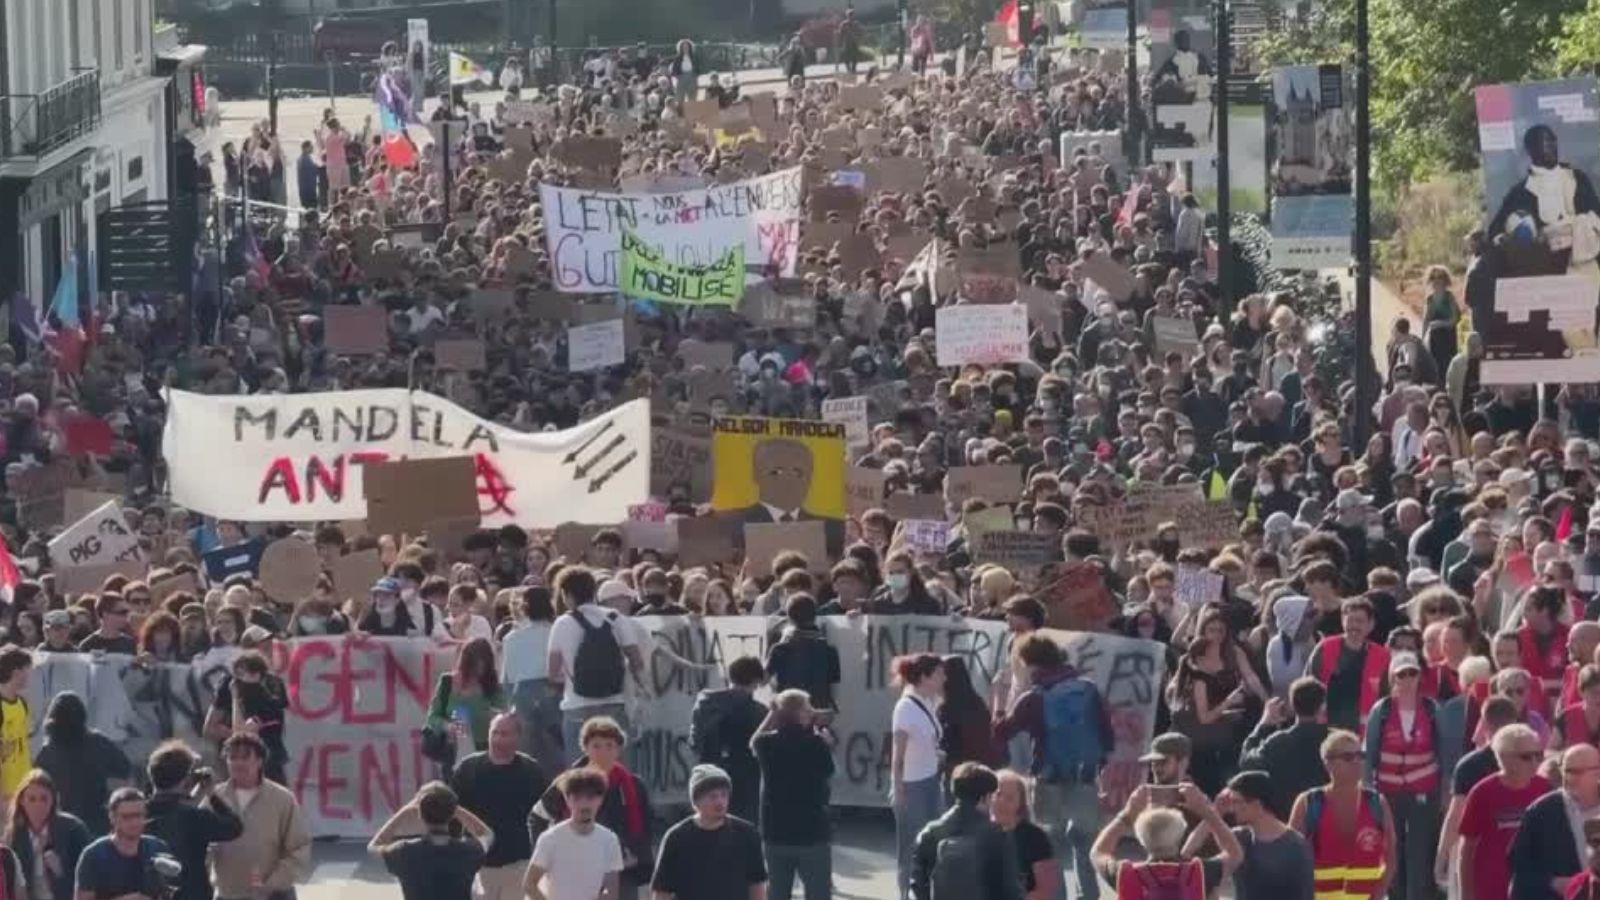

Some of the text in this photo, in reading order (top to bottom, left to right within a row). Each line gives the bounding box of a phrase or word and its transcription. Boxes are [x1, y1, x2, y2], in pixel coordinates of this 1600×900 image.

[233, 404, 499, 453] MANDELA
[713, 416, 771, 434] NELSON
[779, 419, 847, 439] MANDELA
